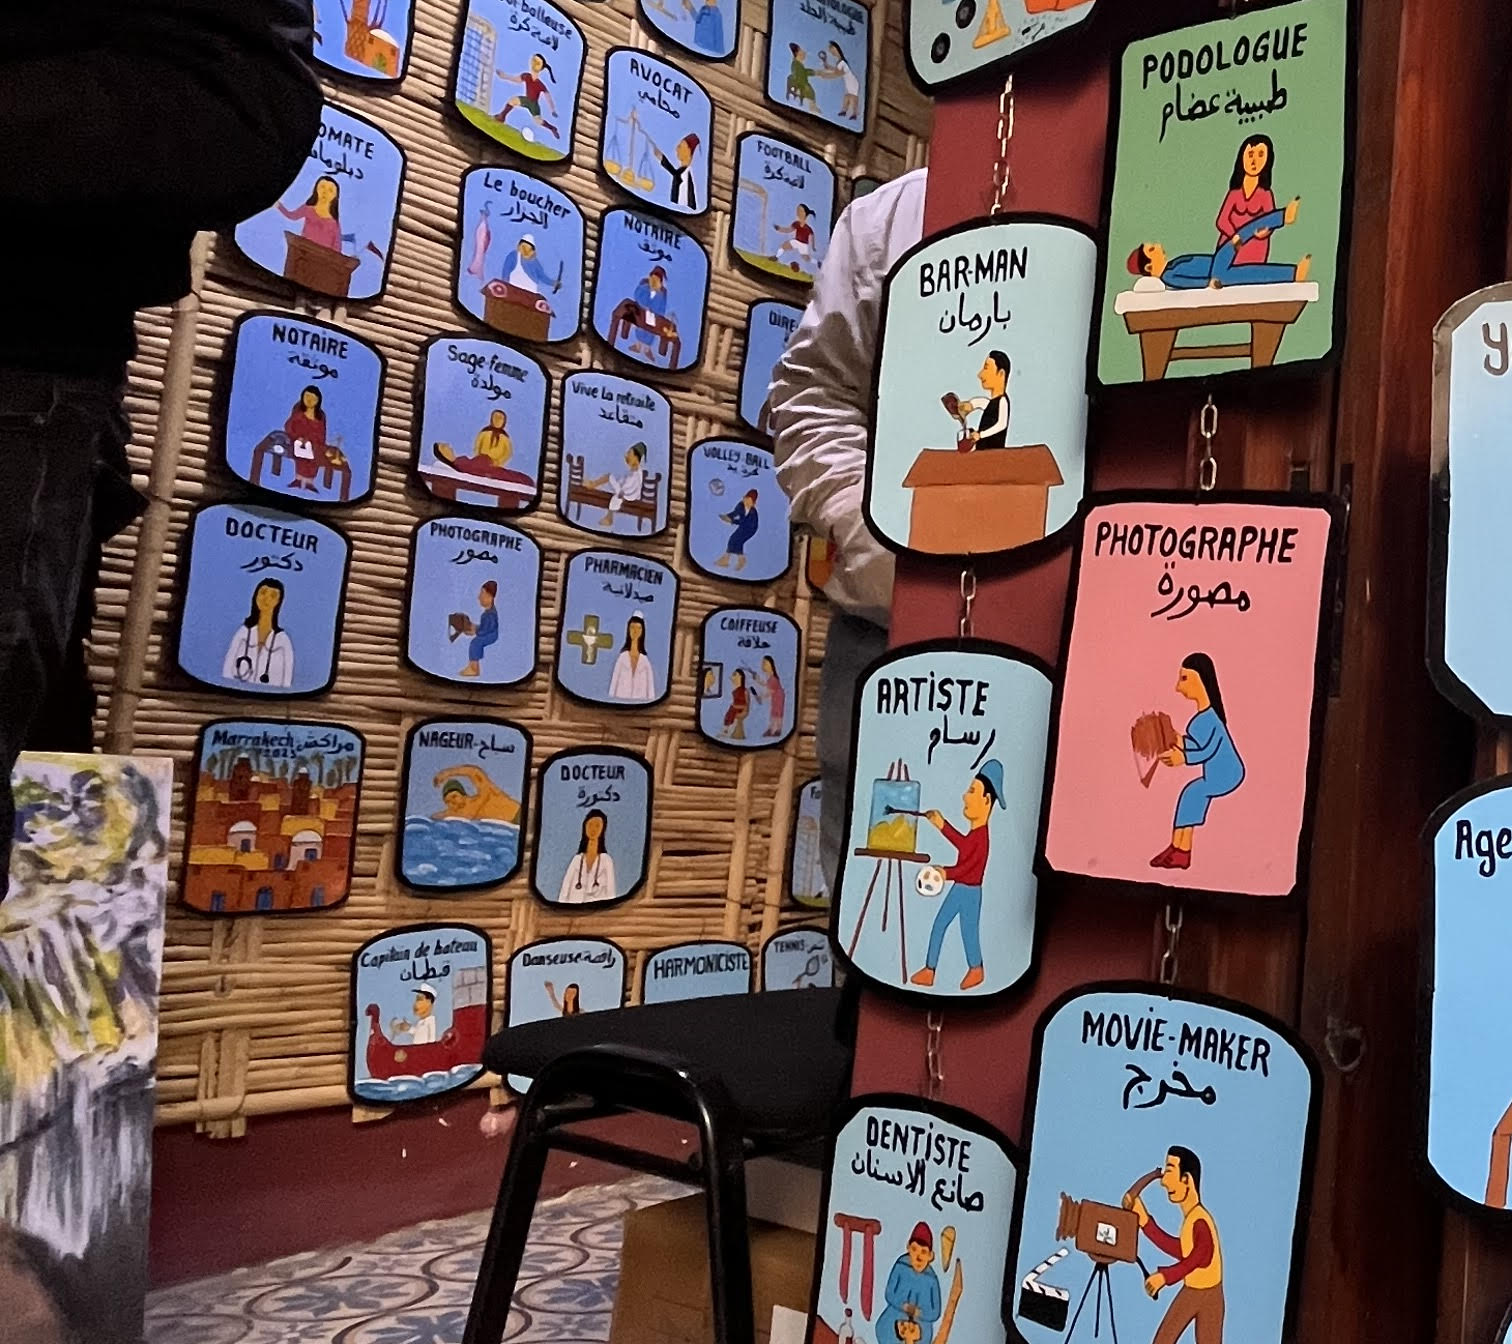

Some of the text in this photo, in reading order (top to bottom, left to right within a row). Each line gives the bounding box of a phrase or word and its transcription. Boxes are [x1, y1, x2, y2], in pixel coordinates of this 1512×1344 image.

[1142, 22, 1309, 89] PODOLOGUE
[630, 57, 694, 105] AVOCAT
[757, 140, 812, 174] FOOTBALL
[483, 172, 571, 219] Le boucher
[623, 214, 682, 251] NOTAIRE
[272, 322, 349, 360] NOTAIRE
[572, 380, 599, 400] Vive
[225, 517, 319, 554] DOCTEUR
[430, 520, 524, 552] PHOTOGRAPHE
[1095, 520, 1299, 564] PHOTOGRAPHE
[584, 556, 664, 586] PHARMACIEN
[720, 614, 779, 635] COIFFEUSE
[876, 670, 991, 716] ARTISTE
[211, 727, 295, 749] Marrakech
[927, 715, 996, 770] رسام
[560, 764, 626, 782] DOCTEUR
[414, 940, 430, 958] de
[1082, 1005, 1272, 1078] MOVIE-MAKER
[866, 1115, 973, 1174] DENTISTE
